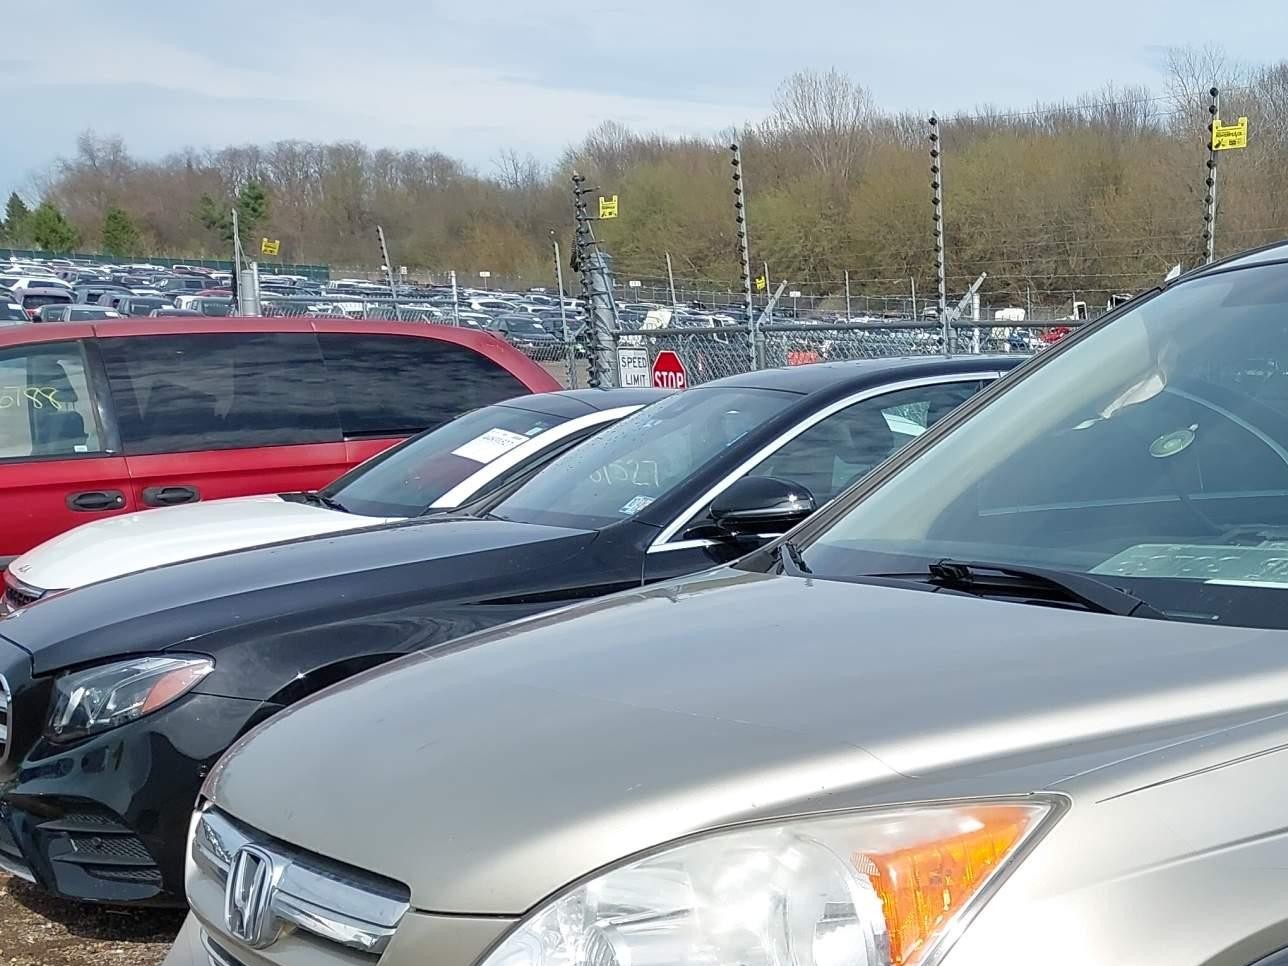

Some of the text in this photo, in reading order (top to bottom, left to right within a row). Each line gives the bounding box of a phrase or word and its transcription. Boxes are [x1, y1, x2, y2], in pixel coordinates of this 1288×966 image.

[621, 357, 647, 368] SPEED
[625, 374, 646, 386] LIMIT
[655, 371, 684, 389] STOP
